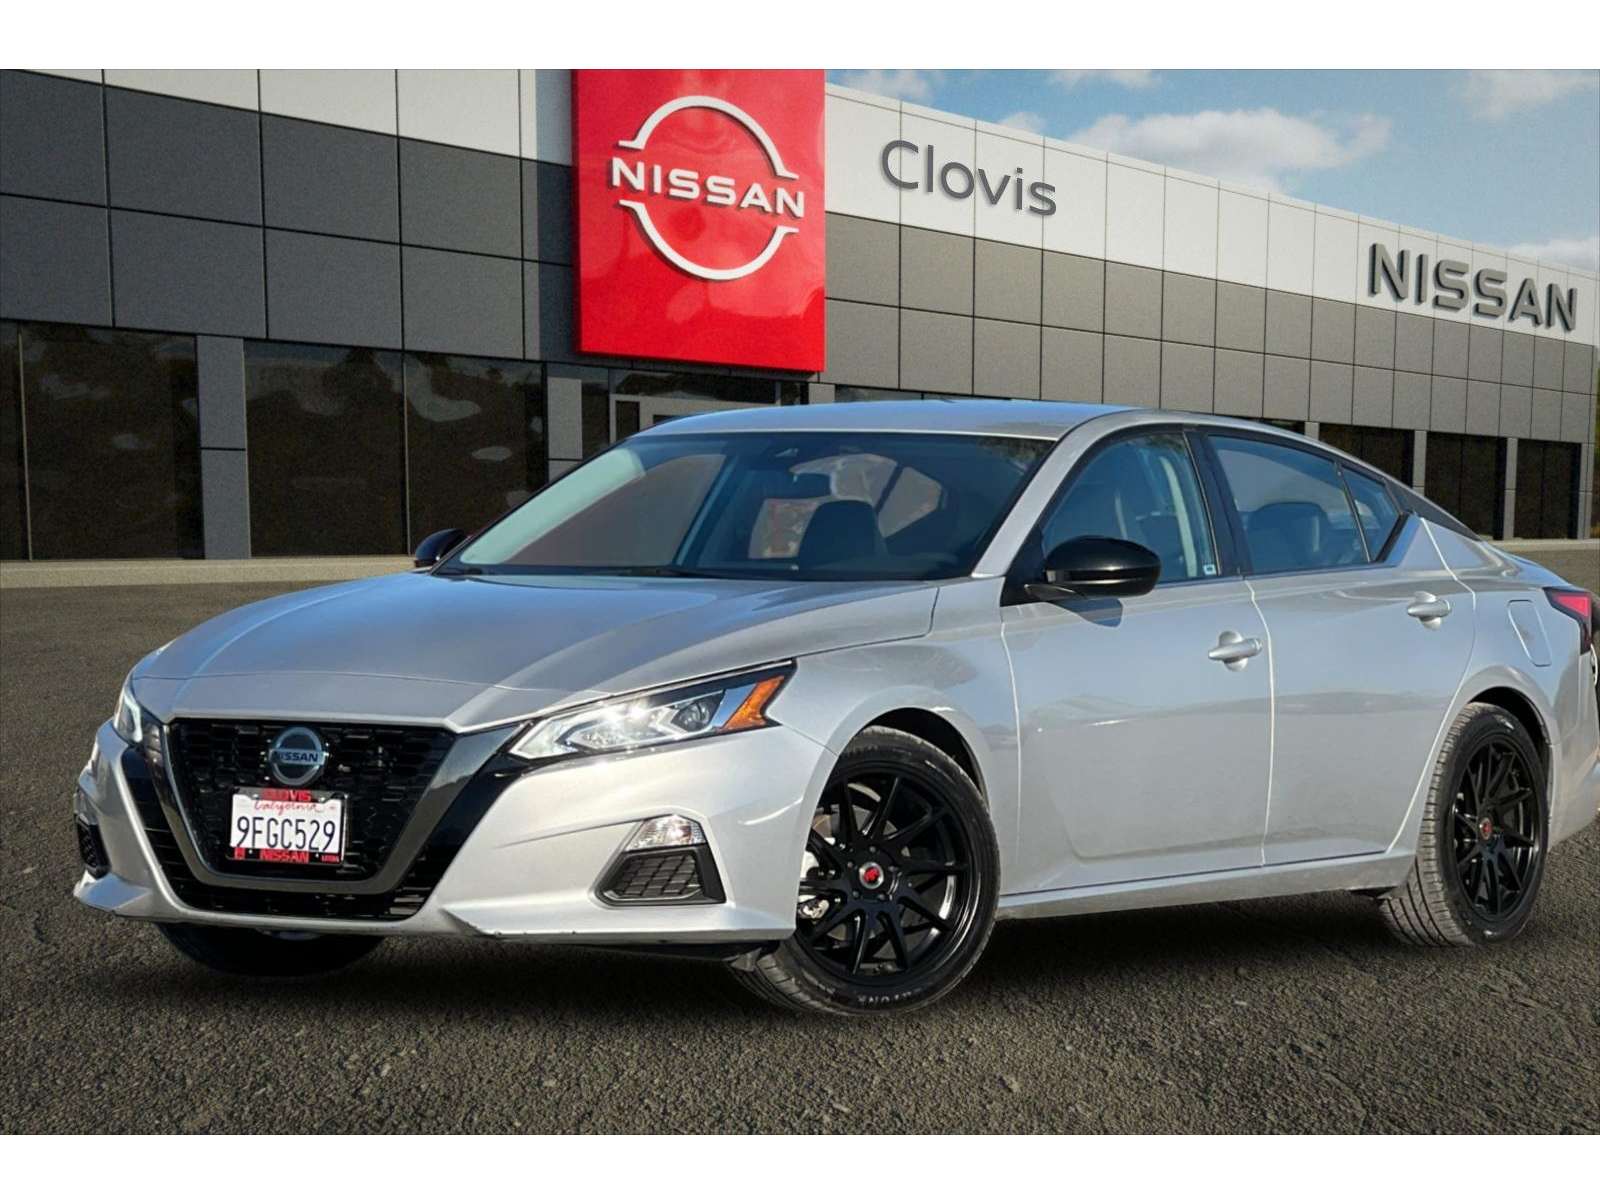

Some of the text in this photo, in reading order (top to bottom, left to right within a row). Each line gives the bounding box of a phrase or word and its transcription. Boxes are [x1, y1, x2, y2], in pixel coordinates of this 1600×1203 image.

[611, 156, 805, 219] NISSAN
[881, 139, 1058, 216] Clovis
[1368, 242, 1578, 332] NISSAN
[236, 816, 336, 852] 9FGC529
[260, 848, 309, 864] NISSAN
